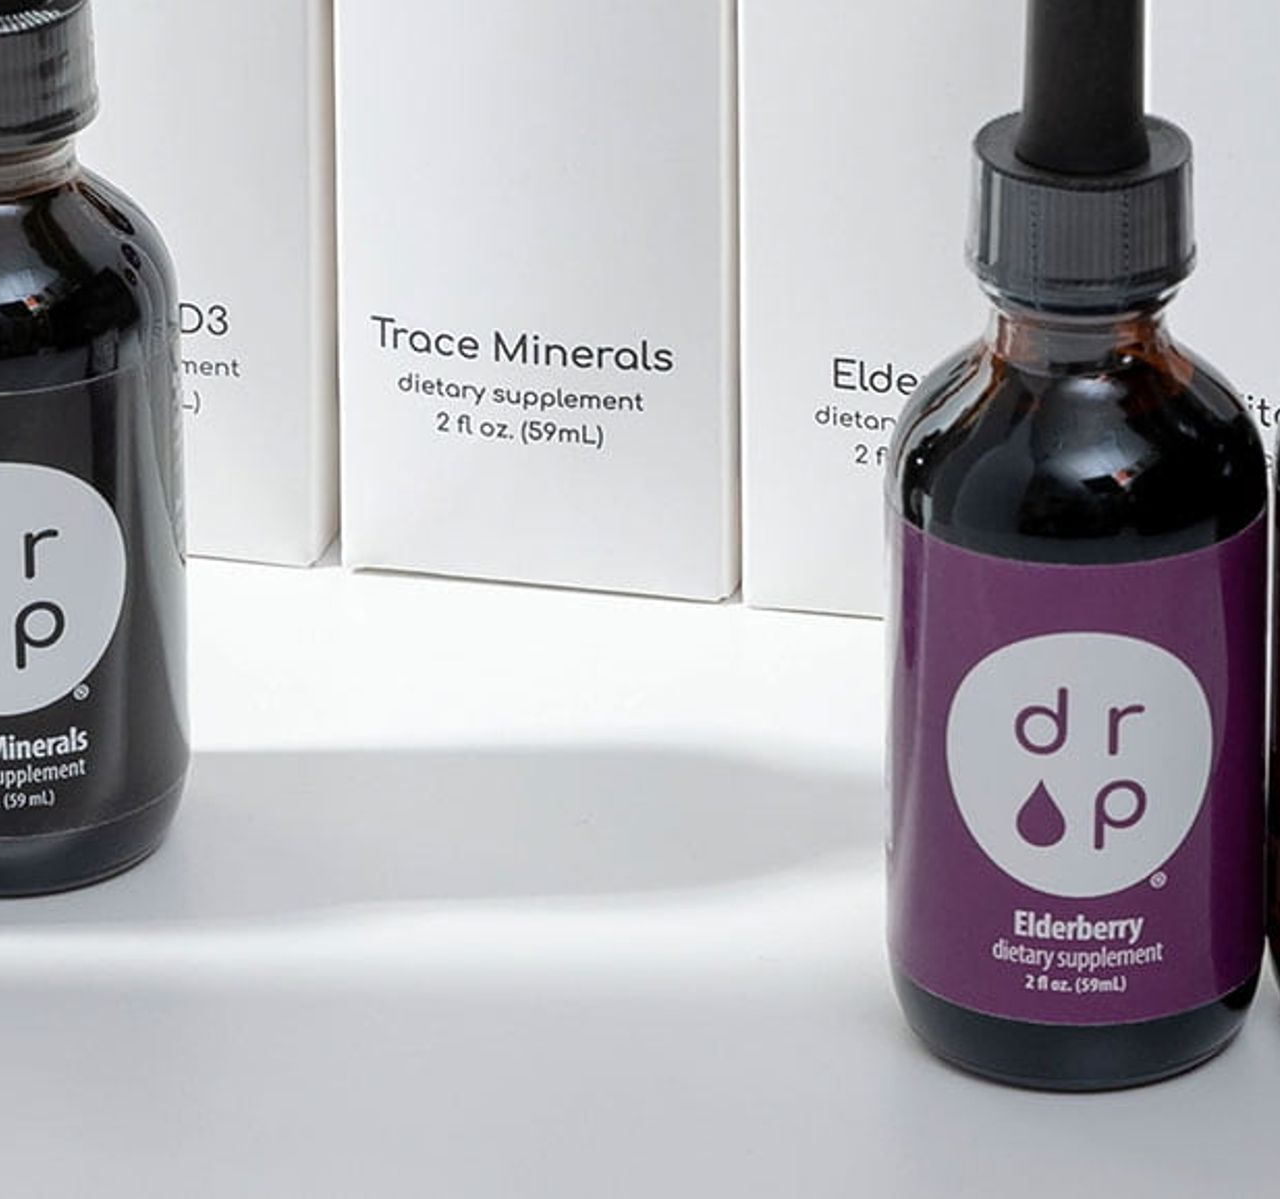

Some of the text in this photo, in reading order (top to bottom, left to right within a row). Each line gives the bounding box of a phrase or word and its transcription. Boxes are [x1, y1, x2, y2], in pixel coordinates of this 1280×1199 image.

[178, 302, 229, 336] D3
[370, 314, 675, 373] Trace Minerals
[397, 372, 645, 413] dietary supplement
[436, 411, 605, 450] 2 fl oz. (59mL)
[814, 404, 898, 432] dietar
[854, 443, 869, 465] 2
[1013, 909, 1145, 945] Elderberry
[992, 938, 1164, 973] dietary supplement
[1024, 974, 1035, 990] 2
[1037, 974, 1048, 991] fl
[1075, 975, 1128, 994] (59mL)
